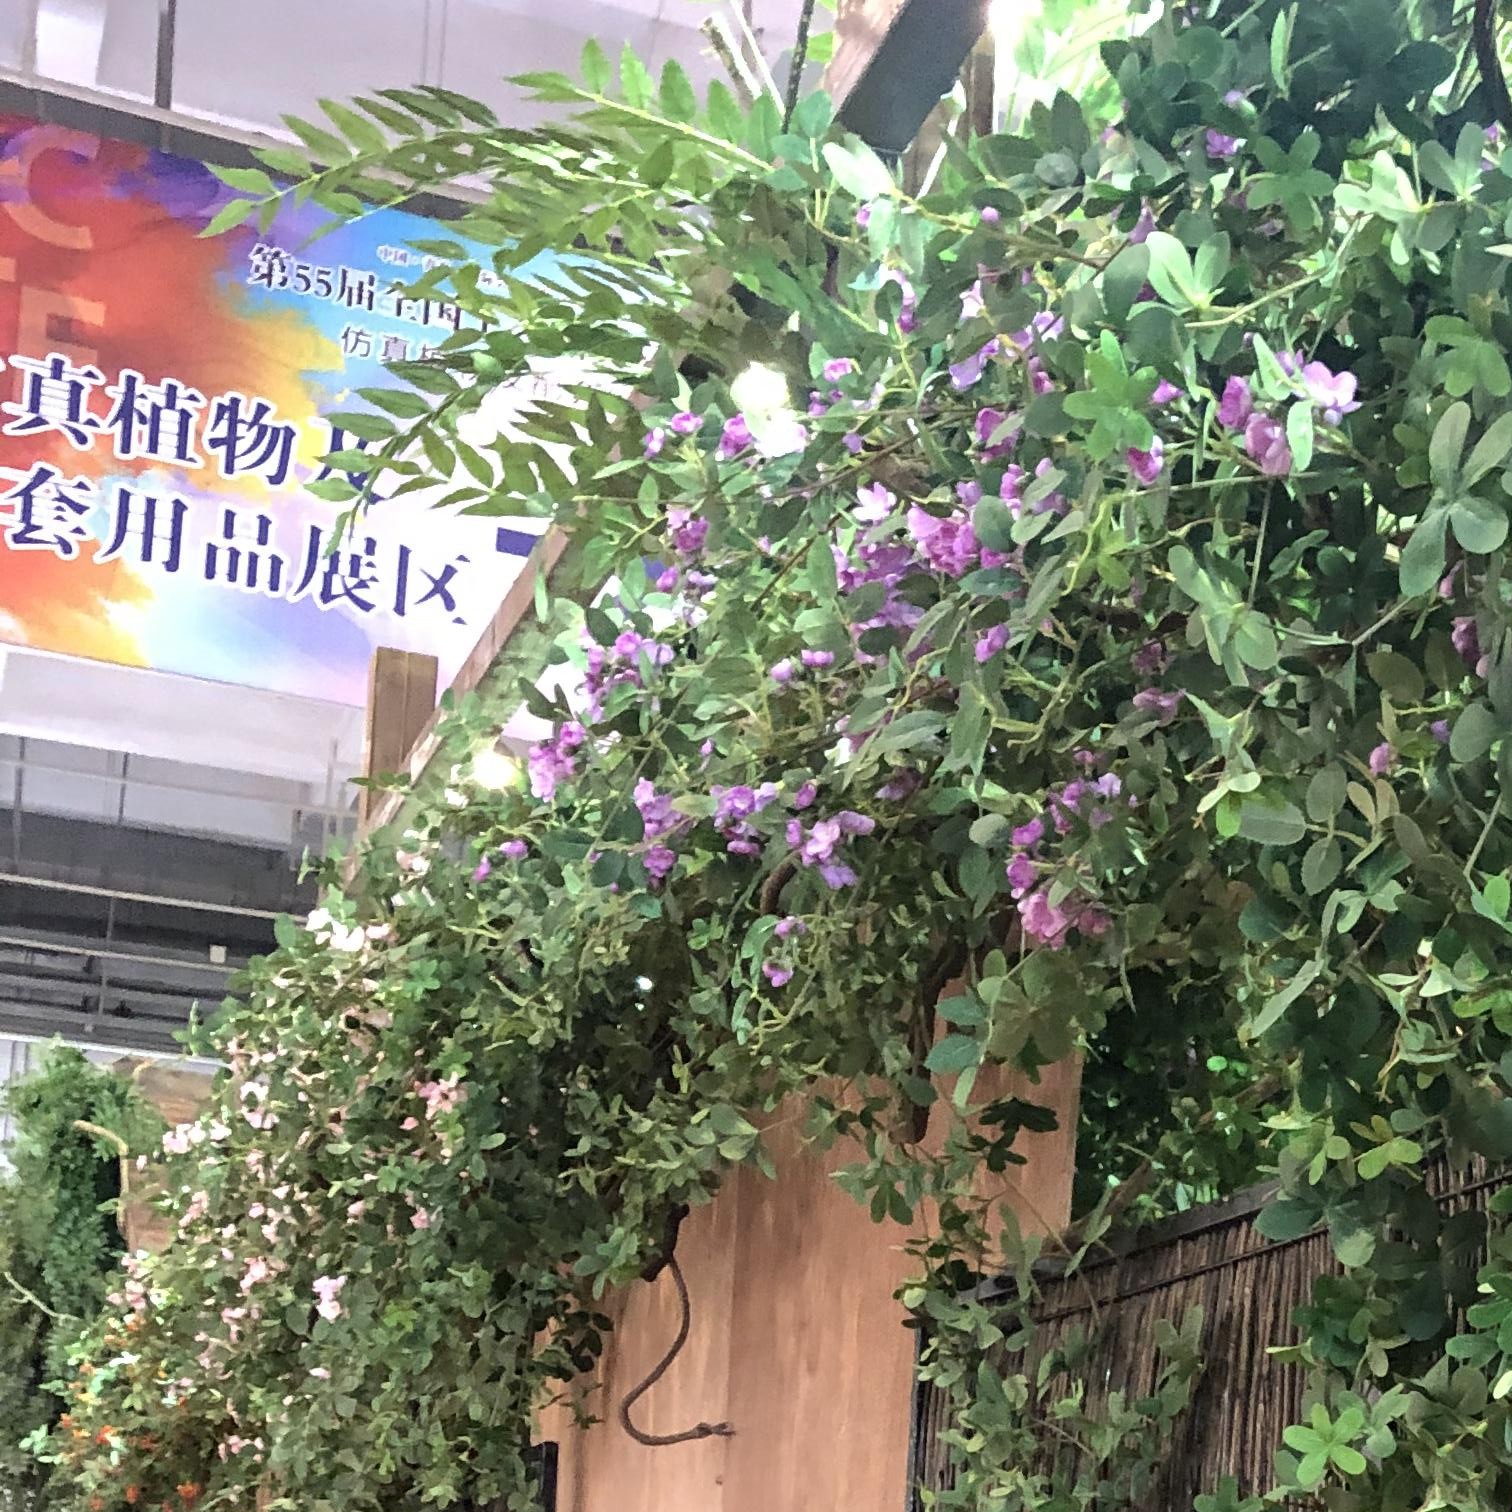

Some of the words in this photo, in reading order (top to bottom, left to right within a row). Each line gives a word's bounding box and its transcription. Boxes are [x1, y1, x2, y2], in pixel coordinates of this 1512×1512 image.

[249, 243, 488, 332] 第55届全国
[3, 467, 470, 624] 套用品展区
